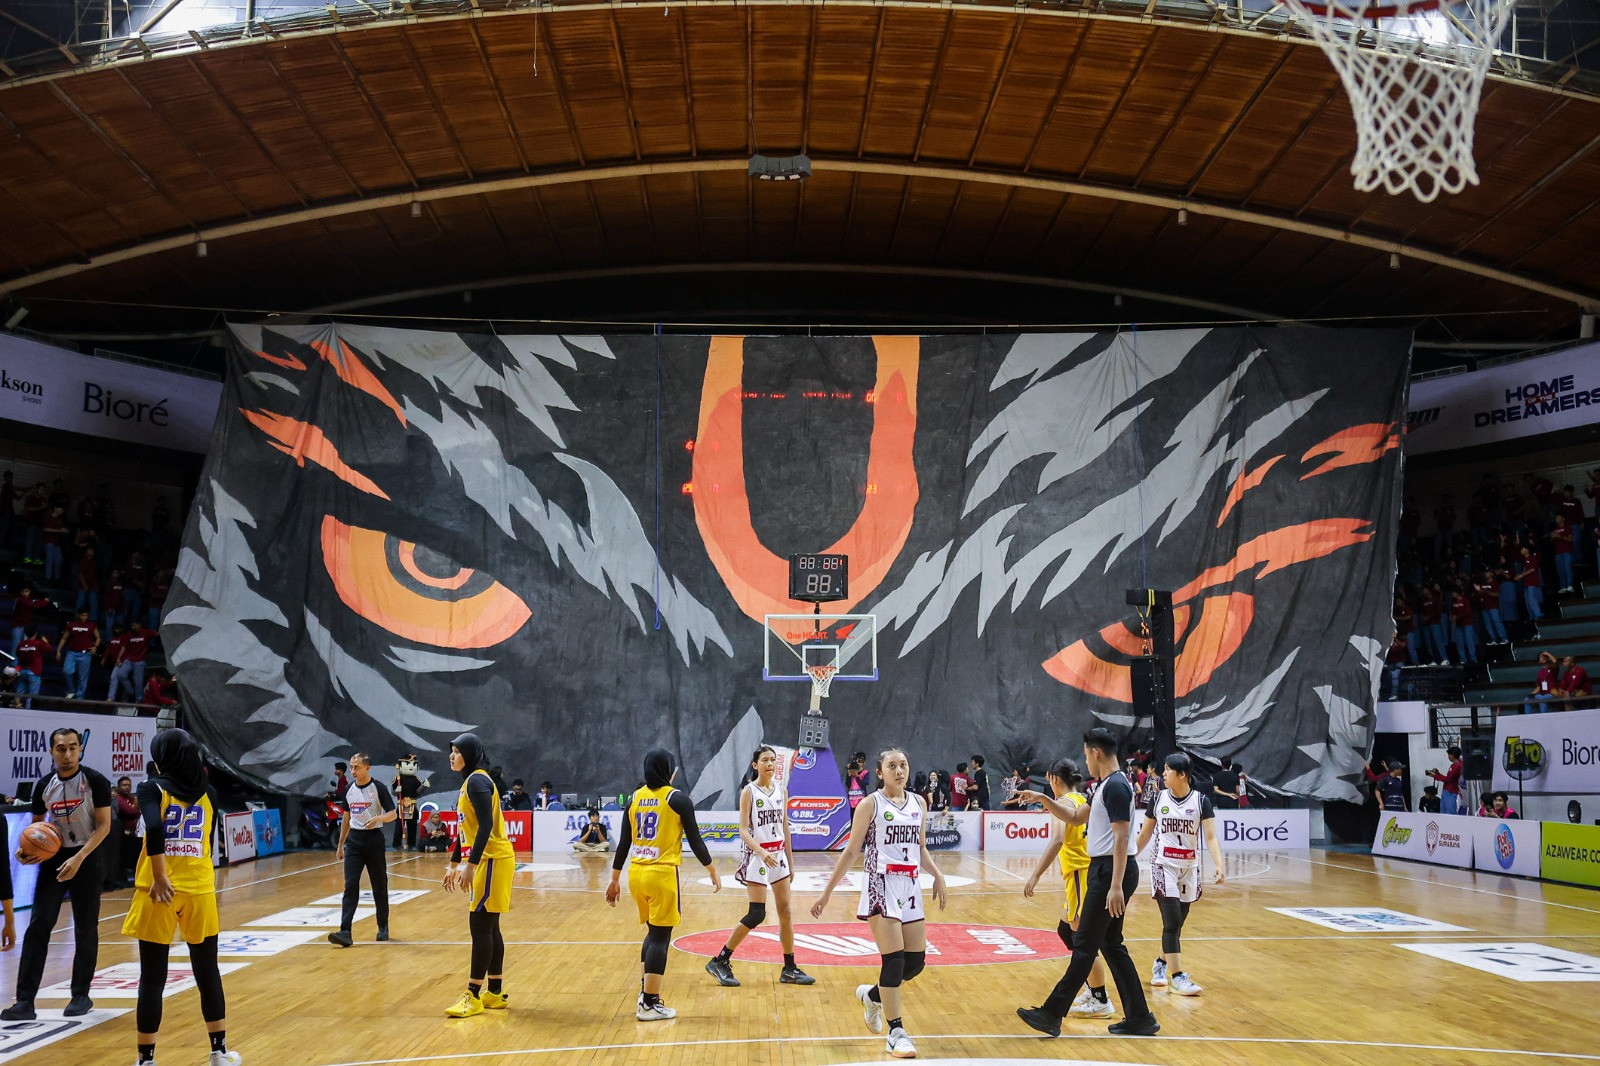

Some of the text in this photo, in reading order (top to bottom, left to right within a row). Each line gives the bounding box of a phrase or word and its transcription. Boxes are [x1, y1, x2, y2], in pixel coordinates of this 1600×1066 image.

[1505, 375, 1574, 404] HOME
[83, 381, 169, 427] Bioré
[1474, 388, 1600, 428] DREAMERS
[786, 632, 801, 640] One
[9, 729, 47, 752] ULTRA
[112, 732, 144, 752] HOT IN
[1561, 738, 1600, 766] Bior
[11, 756, 43, 779] MILK
[112, 754, 144, 772] CREAM
[774, 753, 785, 781] CREAM
[161, 804, 205, 842] 22
[564, 814, 612, 831] AQA
[799, 810, 815, 819] DBL
[635, 811, 660, 841] 18
[771, 826, 777, 837] 4
[884, 825, 921, 845] SABERS
[1005, 822, 1049, 839] Good
[1161, 817, 1195, 835] SABERS
[1223, 819, 1289, 842] Bioré
[1176, 834, 1183, 847] 1
[1438, 840, 1460, 849] SURABAYA
[1440, 832, 1460, 842] PERBASI
[908, 895, 916, 910] 7
